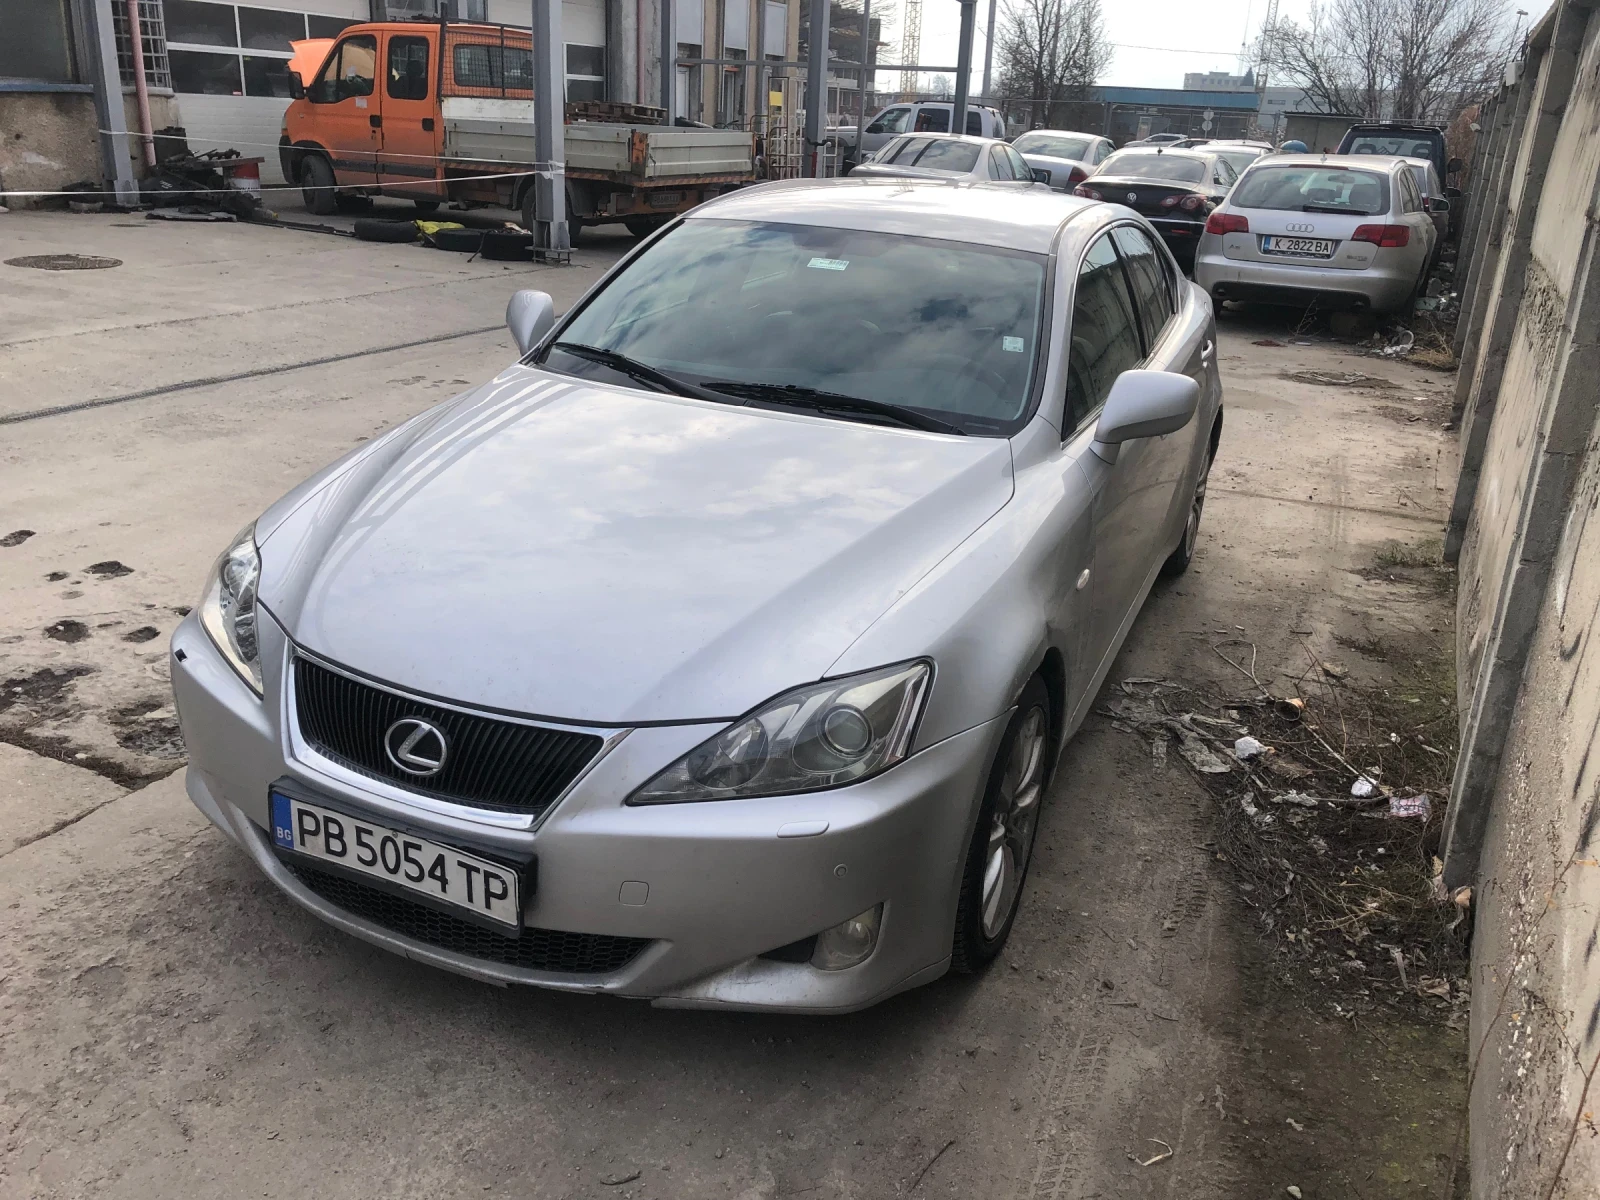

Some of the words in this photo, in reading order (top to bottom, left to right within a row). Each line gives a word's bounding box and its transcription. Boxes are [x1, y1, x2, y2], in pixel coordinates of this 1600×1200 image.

[1274, 238, 1283, 250] K
[1286, 239, 1314, 252] 2822
[1314, 241, 1330, 253] BA
[276, 826, 292, 841] BG
[297, 807, 347, 858] PB
[354, 824, 449, 894] 5054
[456, 859, 509, 911] TP
